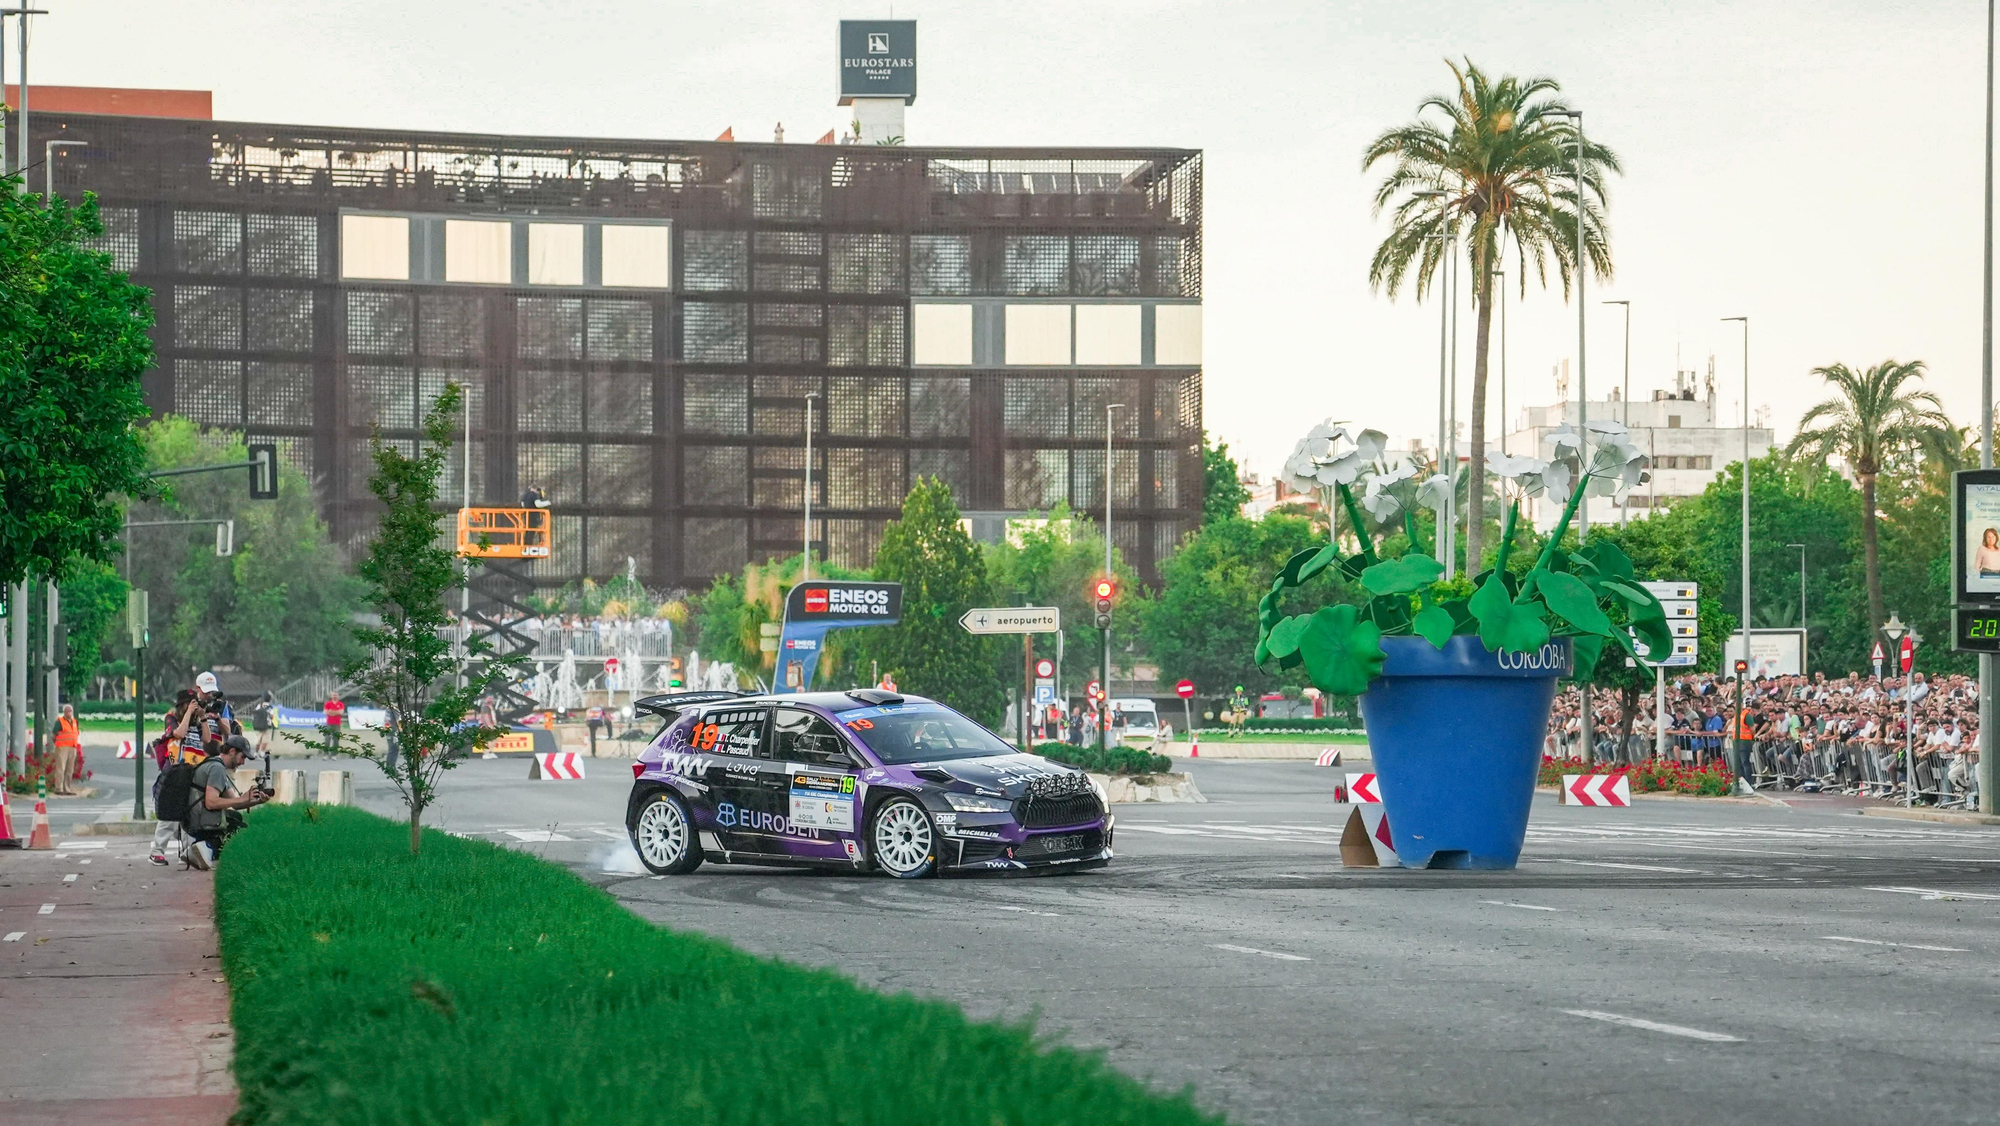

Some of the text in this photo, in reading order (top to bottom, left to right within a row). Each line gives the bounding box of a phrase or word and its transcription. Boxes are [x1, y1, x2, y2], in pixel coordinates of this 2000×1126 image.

[844, 58, 914, 68] EUROSTARS
[829, 588, 889, 605] ENEOS
[829, 603, 889, 615] MOTOR OIL
[997, 616, 1053, 626] aeropuerto
[1970, 619, 1997, 637] 20
[1039, 688, 1051, 703] P
[845, 718, 875, 732] 19
[690, 722, 719, 750] 19
[726, 745, 749, 756] Pascaud
[841, 776, 854, 794] 19
[740, 808, 819, 839] EUROBEN
[936, 814, 957, 824] OMP
[957, 829, 999, 838] MICHELIN
